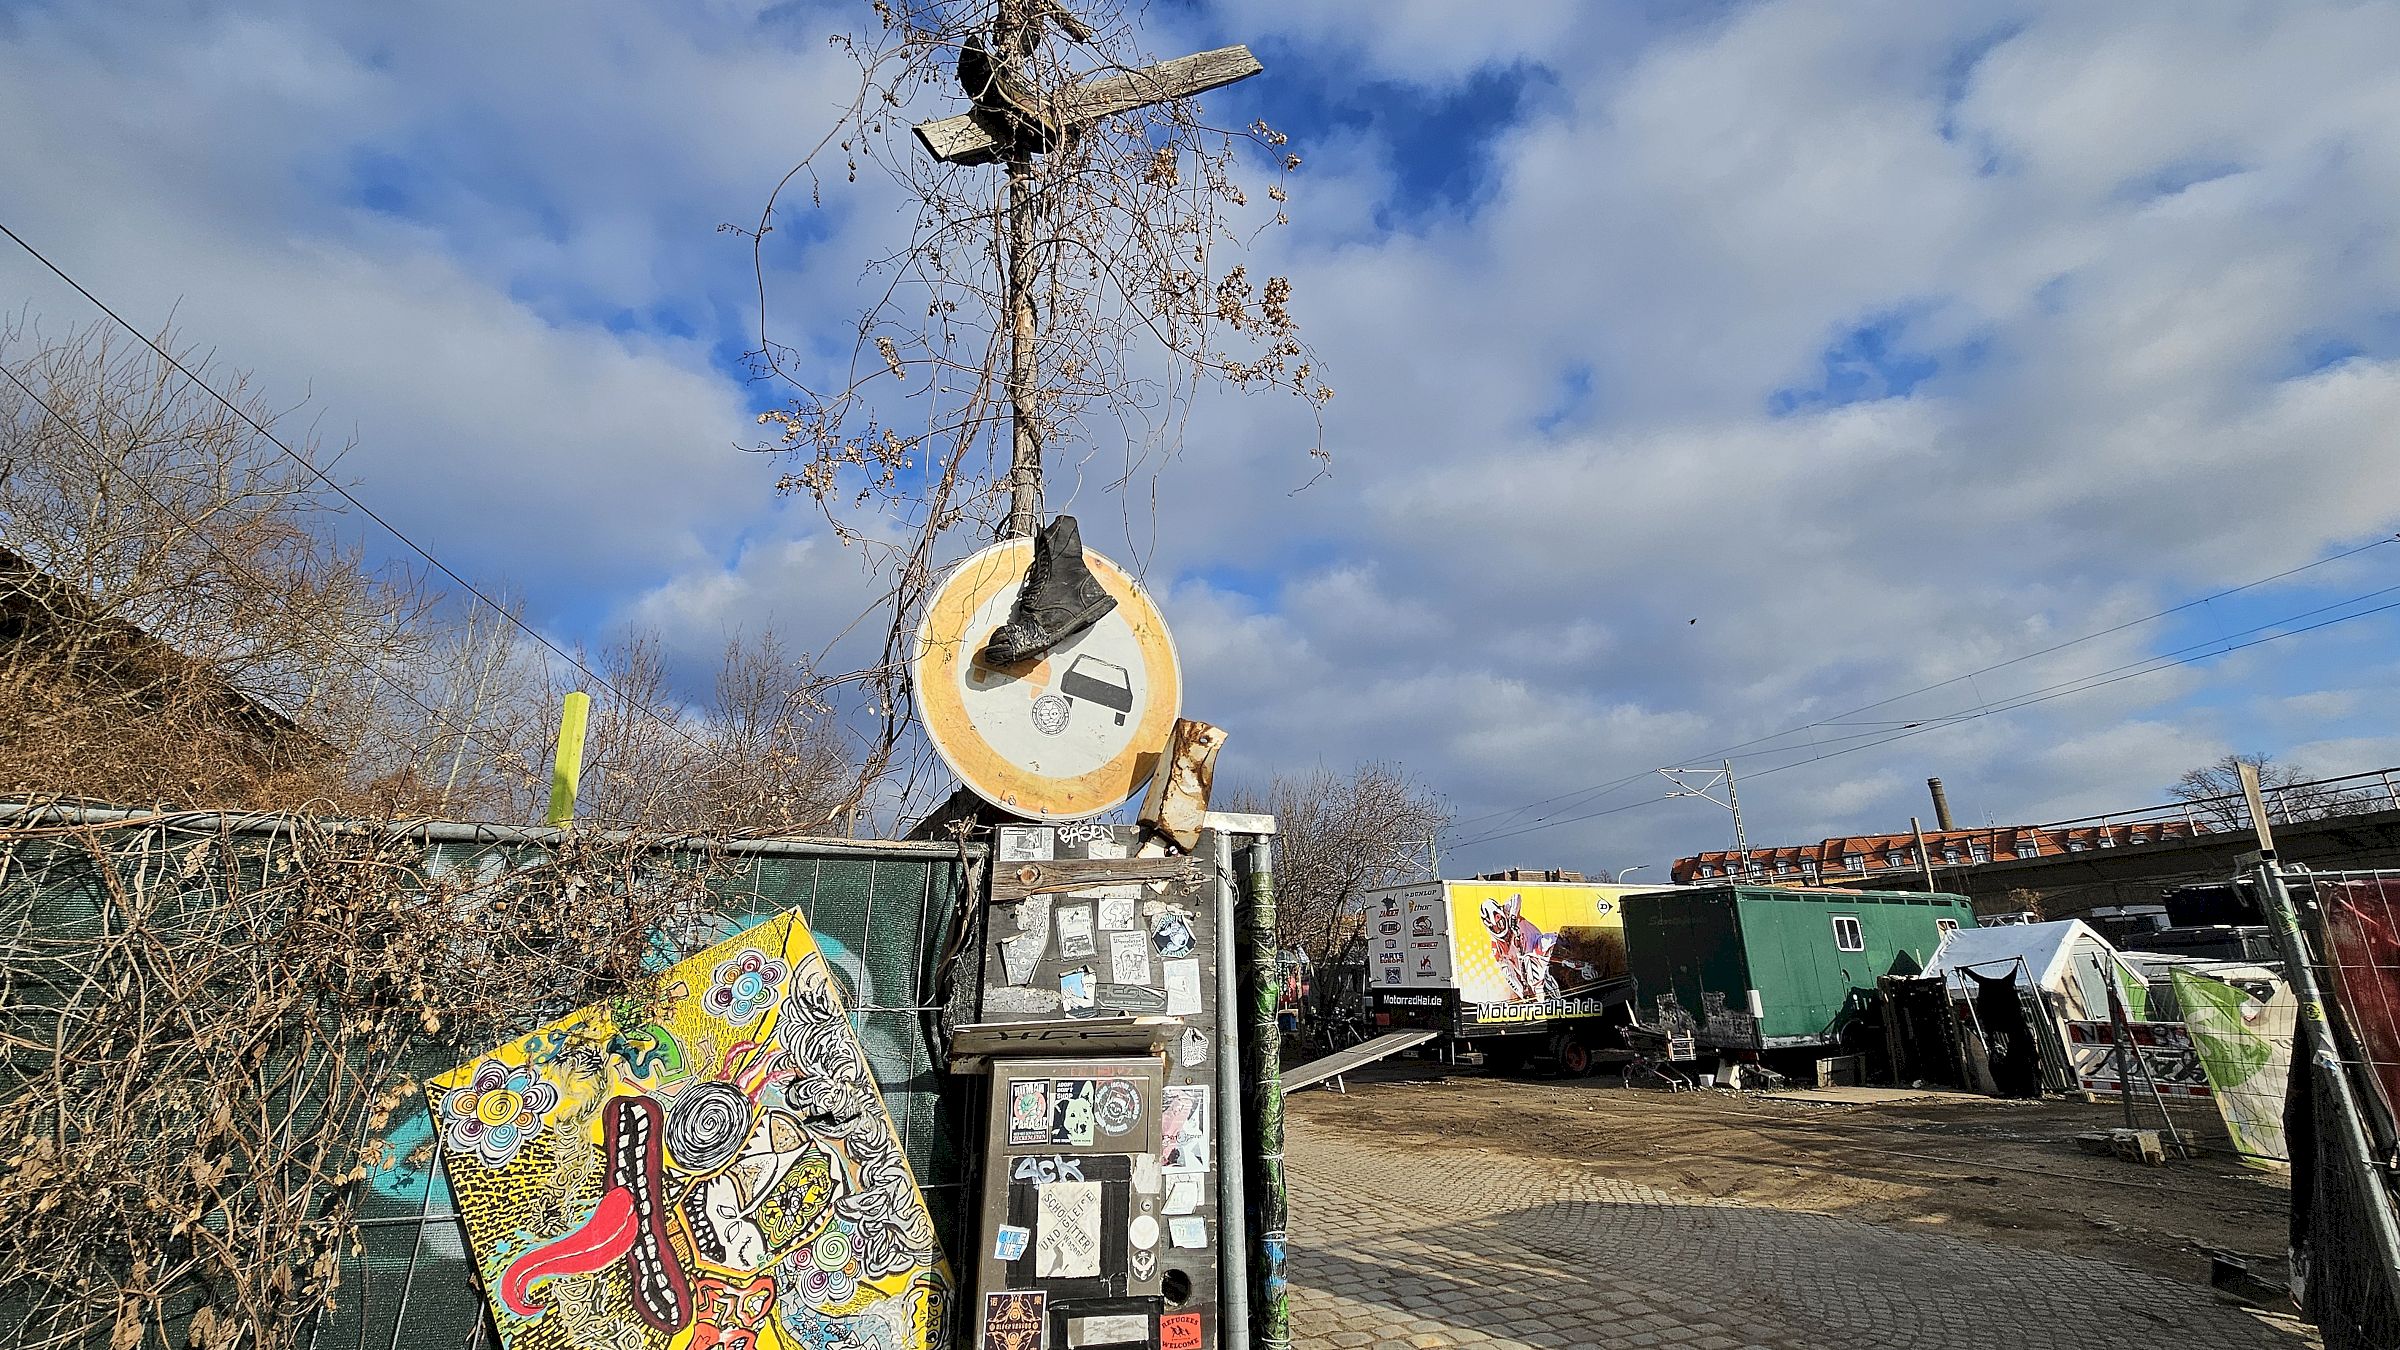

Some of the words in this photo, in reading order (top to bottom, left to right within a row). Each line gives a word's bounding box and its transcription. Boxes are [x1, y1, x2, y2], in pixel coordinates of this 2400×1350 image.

[1410, 890, 1437, 898] DUNLOP
[1414, 903, 1432, 912] thor
[1379, 952, 1404, 960] PARTS
[1383, 994, 1443, 1006] MotorradHai.de
[1476, 998, 1603, 1024] MotorradHai.de
[1056, 1092, 1074, 1100] SHOP
[1040, 1228, 1062, 1251] UND
[1161, 1316, 1199, 1329] REFUGEES
[1162, 1338, 1200, 1349] WELCOME
